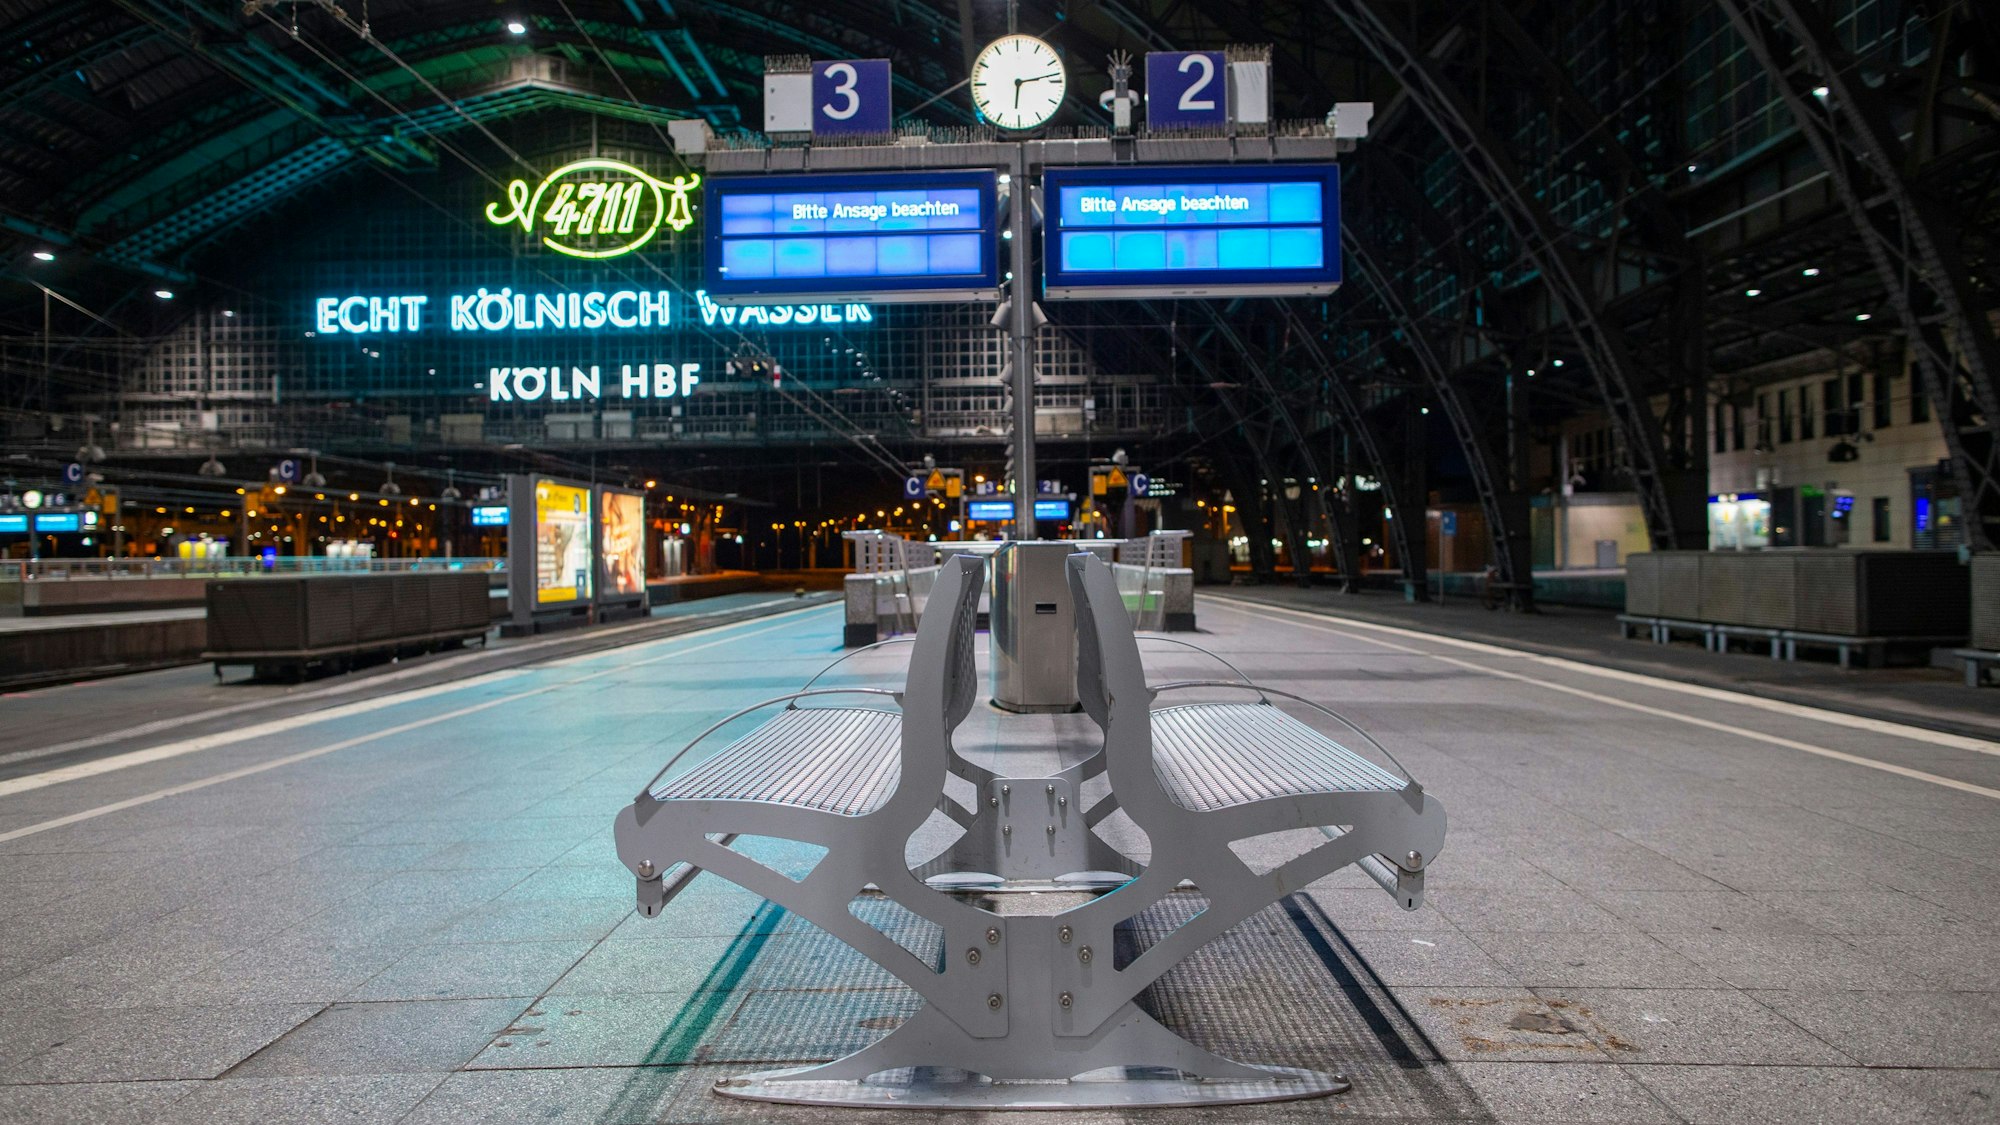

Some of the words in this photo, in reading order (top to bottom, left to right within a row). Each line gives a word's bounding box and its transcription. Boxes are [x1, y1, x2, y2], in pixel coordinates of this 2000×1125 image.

[823, 62, 860, 120] 3
[1178, 53, 1215, 110] 2
[543, 182, 644, 235] 4711
[792, 203, 828, 220] Bitte
[832, 203, 887, 221] Ansage
[891, 200, 959, 217] beachten
[1080, 196, 1117, 213] Bitte
[1121, 196, 1176, 215] Ansage
[1181, 195, 1249, 211] beachten
[316, 295, 428, 334] ECHT
[450, 287, 671, 332] KÖLNISCH
[489, 365, 601, 401] KÖLN
[621, 363, 700, 399] HBF
[67, 463, 81, 482] C
[280, 459, 294, 479] C
[906, 477, 921, 495] C
[986, 481, 995, 493] 3
[1133, 473, 1147, 492] C
